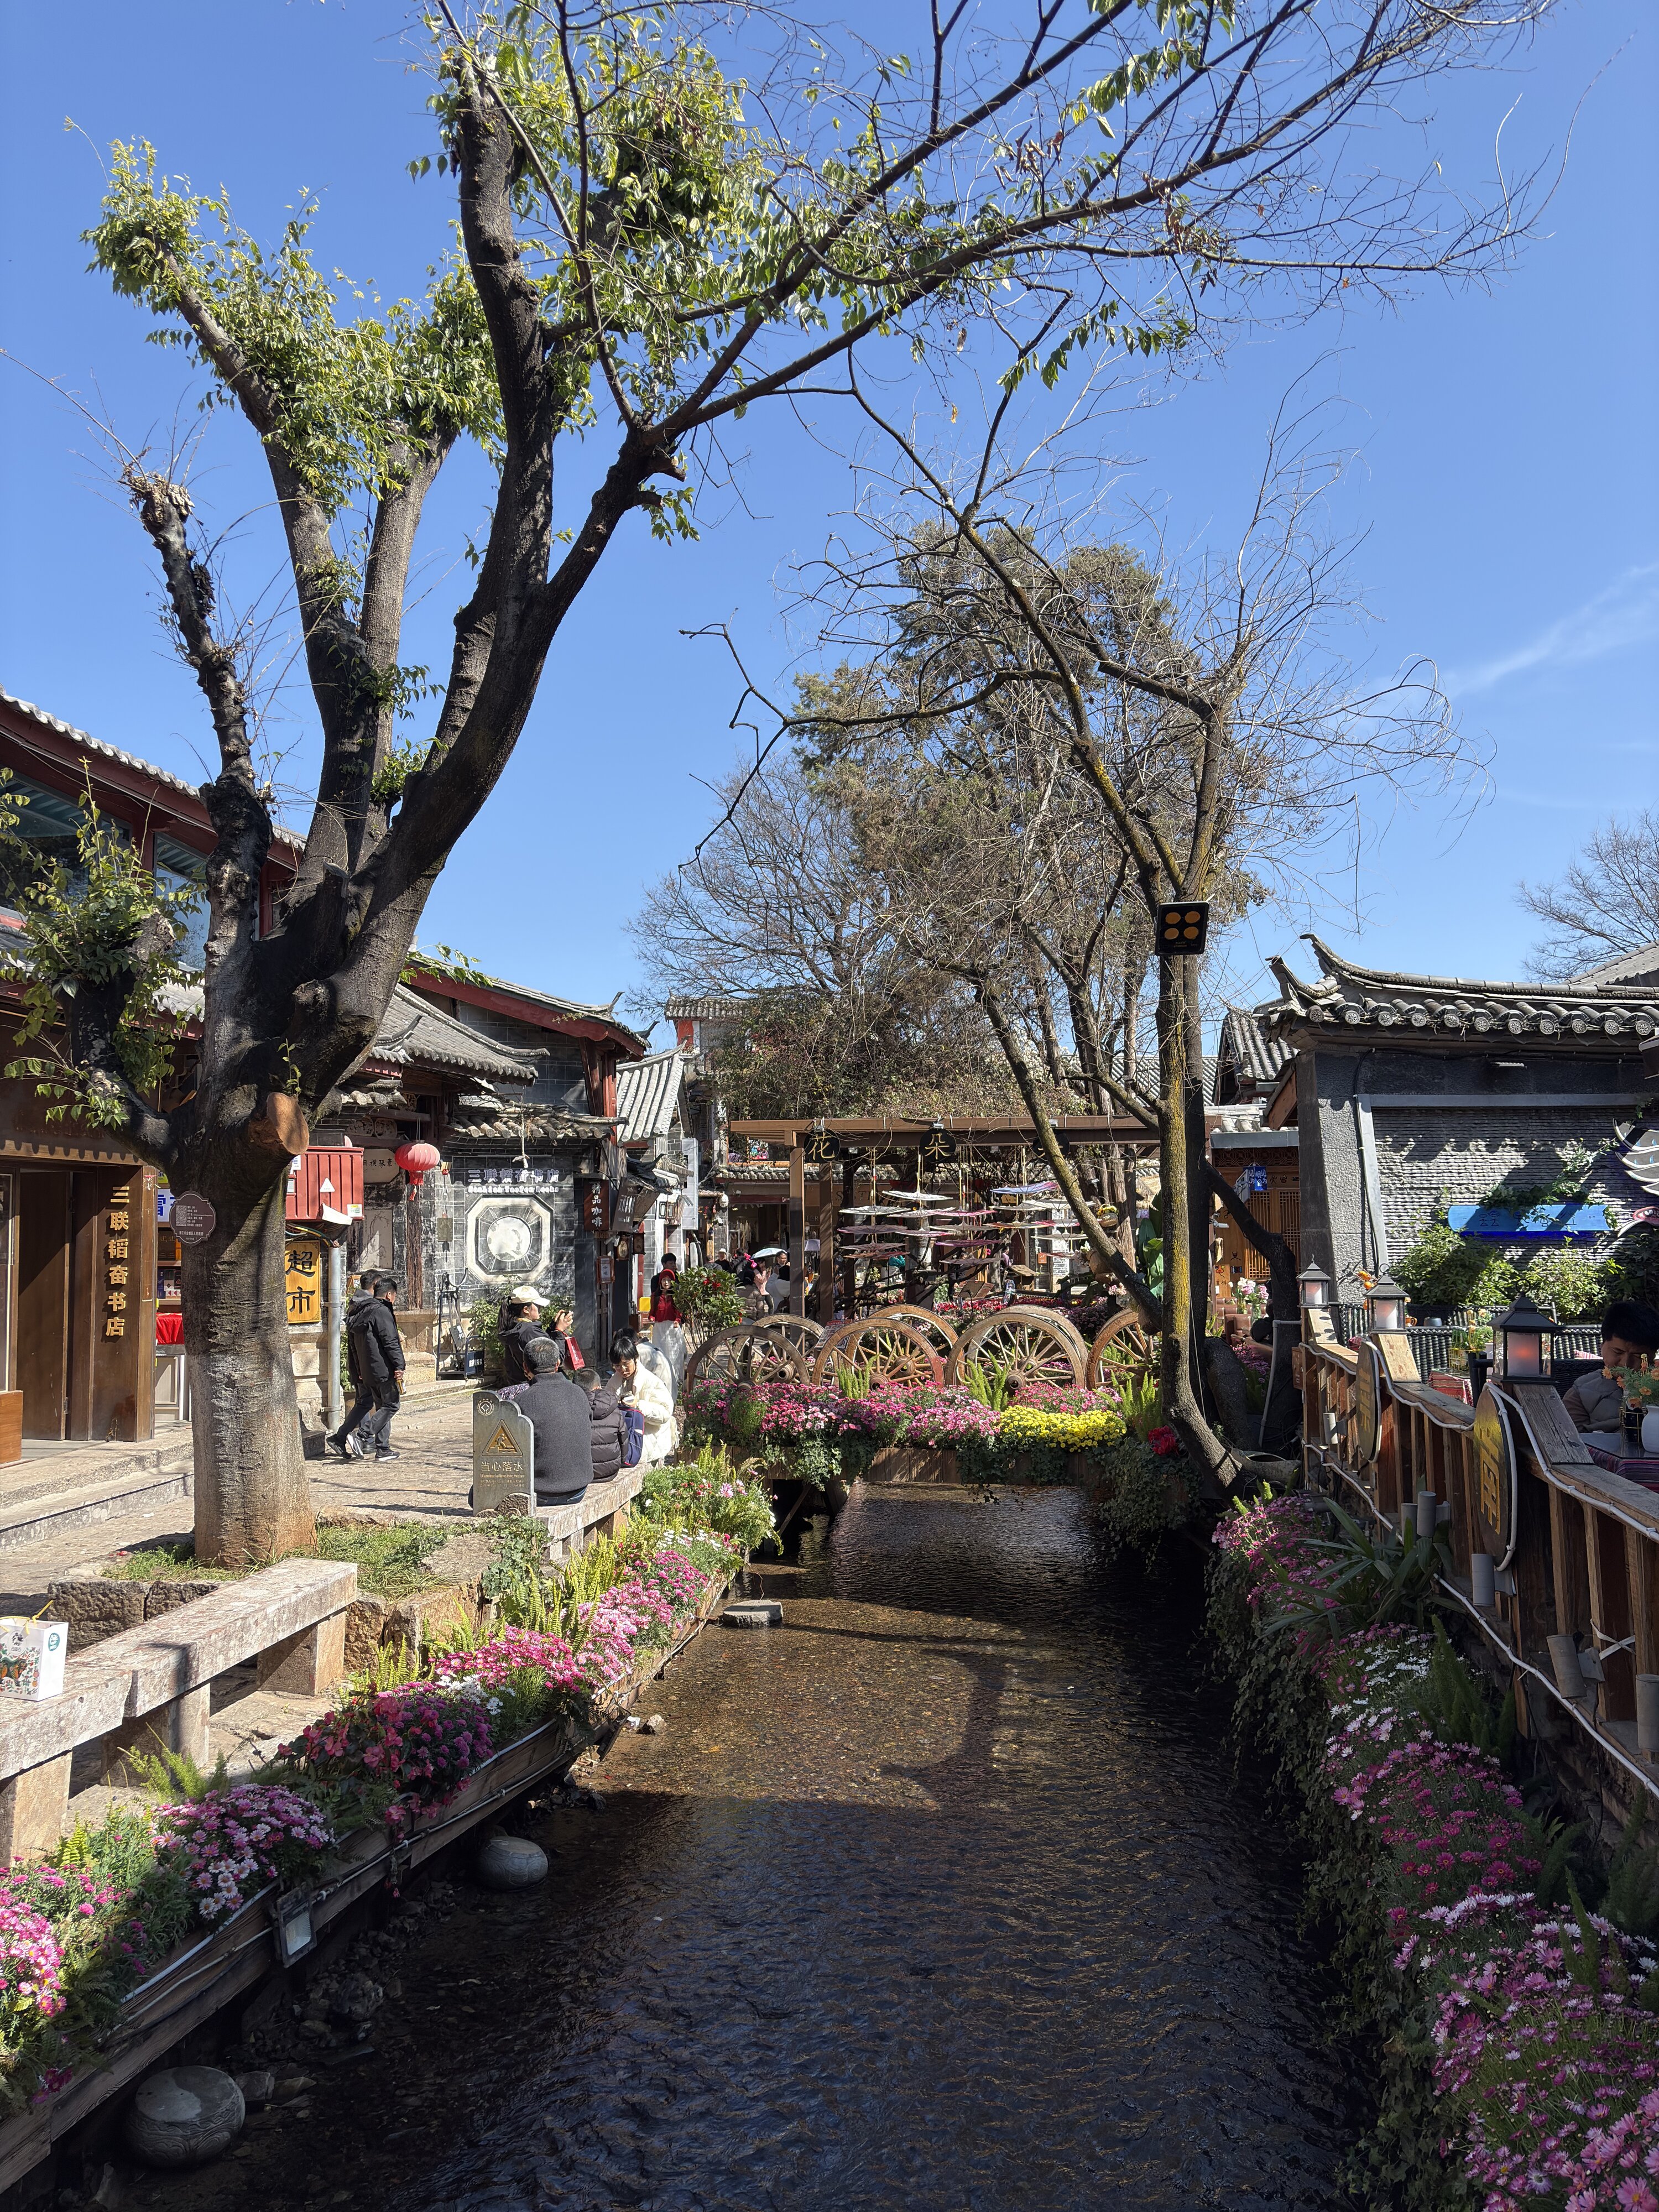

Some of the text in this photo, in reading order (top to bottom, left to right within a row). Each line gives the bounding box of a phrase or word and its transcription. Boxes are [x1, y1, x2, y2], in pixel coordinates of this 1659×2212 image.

[808, 1131, 952, 1161] 花 朵
[468, 1168, 559, 1183] 三联韬奋书店
[591, 1182, 602, 1227] 精品咖啡
[106, 1186, 129, 1336] 三联韬奋书店
[285, 1250, 316, 1314] 超市
[481, 1461, 524, 1472] 当心落水
